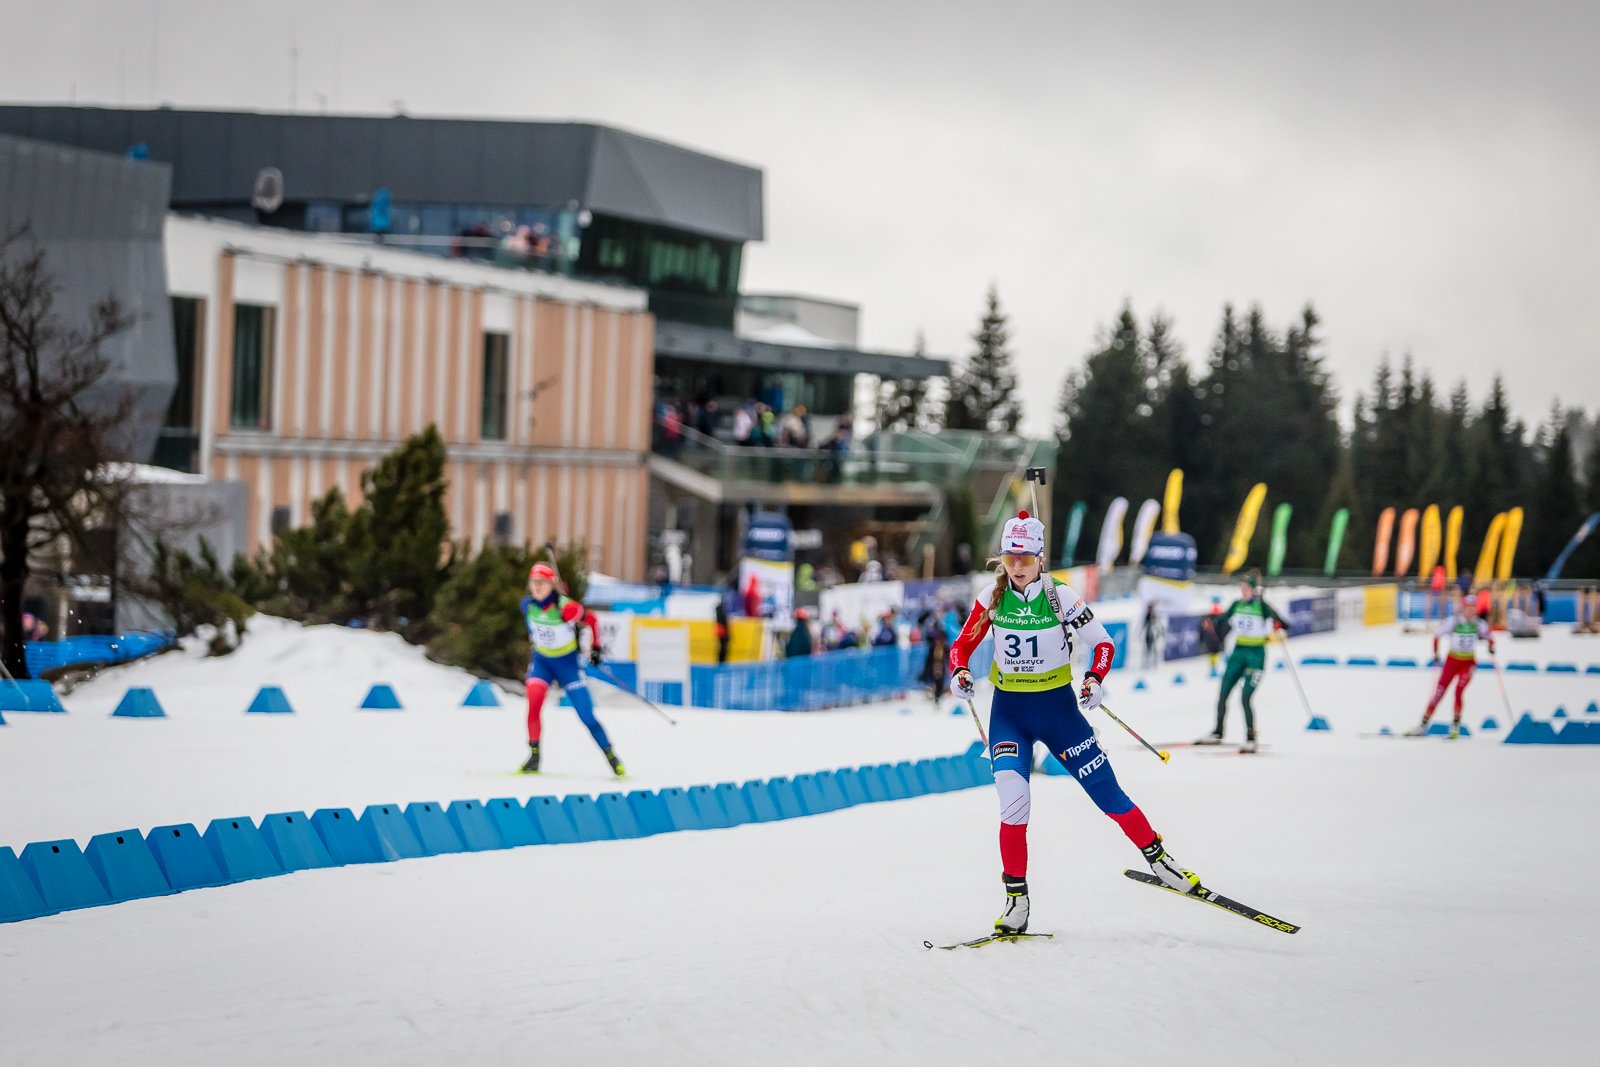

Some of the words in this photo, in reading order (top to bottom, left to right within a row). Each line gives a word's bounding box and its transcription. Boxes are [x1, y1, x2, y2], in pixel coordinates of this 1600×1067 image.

[1004, 633, 1038, 658] 31
[1078, 752, 1107, 779] ATEX
[1253, 914, 1295, 932] FISCHER
